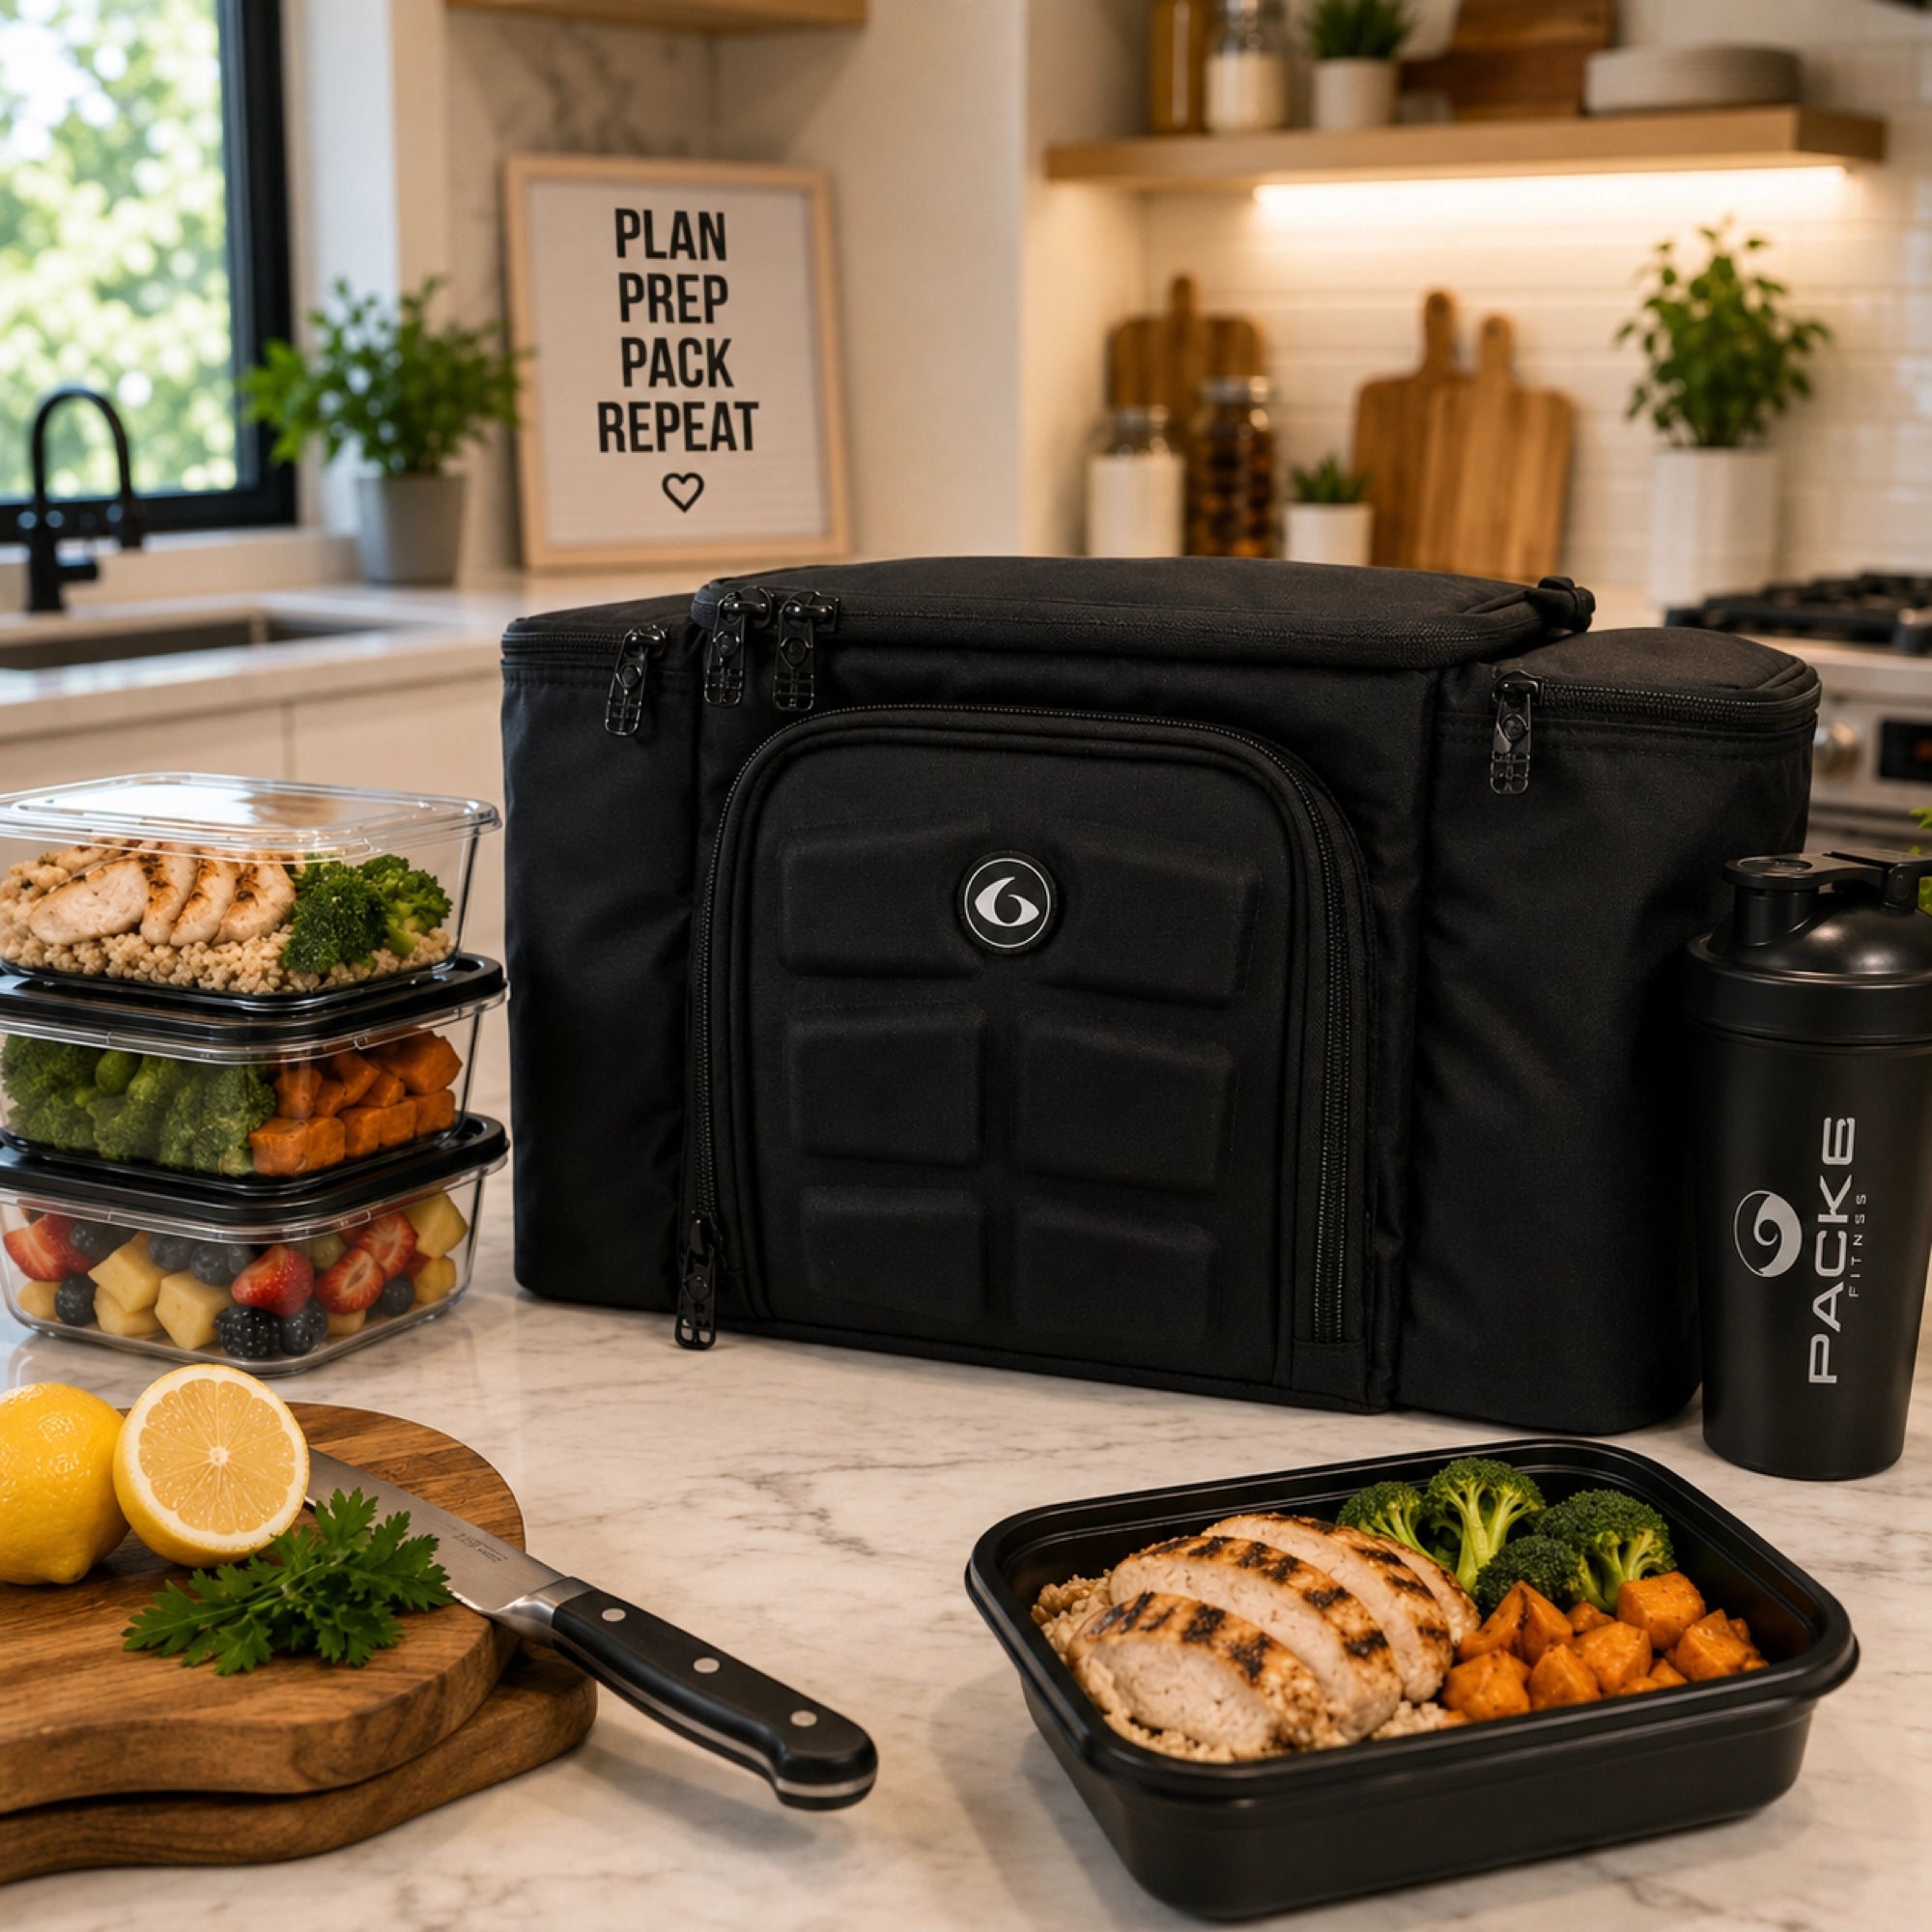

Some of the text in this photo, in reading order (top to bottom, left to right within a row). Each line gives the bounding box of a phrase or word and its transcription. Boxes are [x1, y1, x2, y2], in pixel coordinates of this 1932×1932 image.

[614, 208, 726, 261] PLAN
[618, 272, 728, 324] PREP
[621, 337, 734, 388] PACK
[598, 401, 759, 453] REPEAT
[1849, 1193, 1866, 1298] FITNSS
